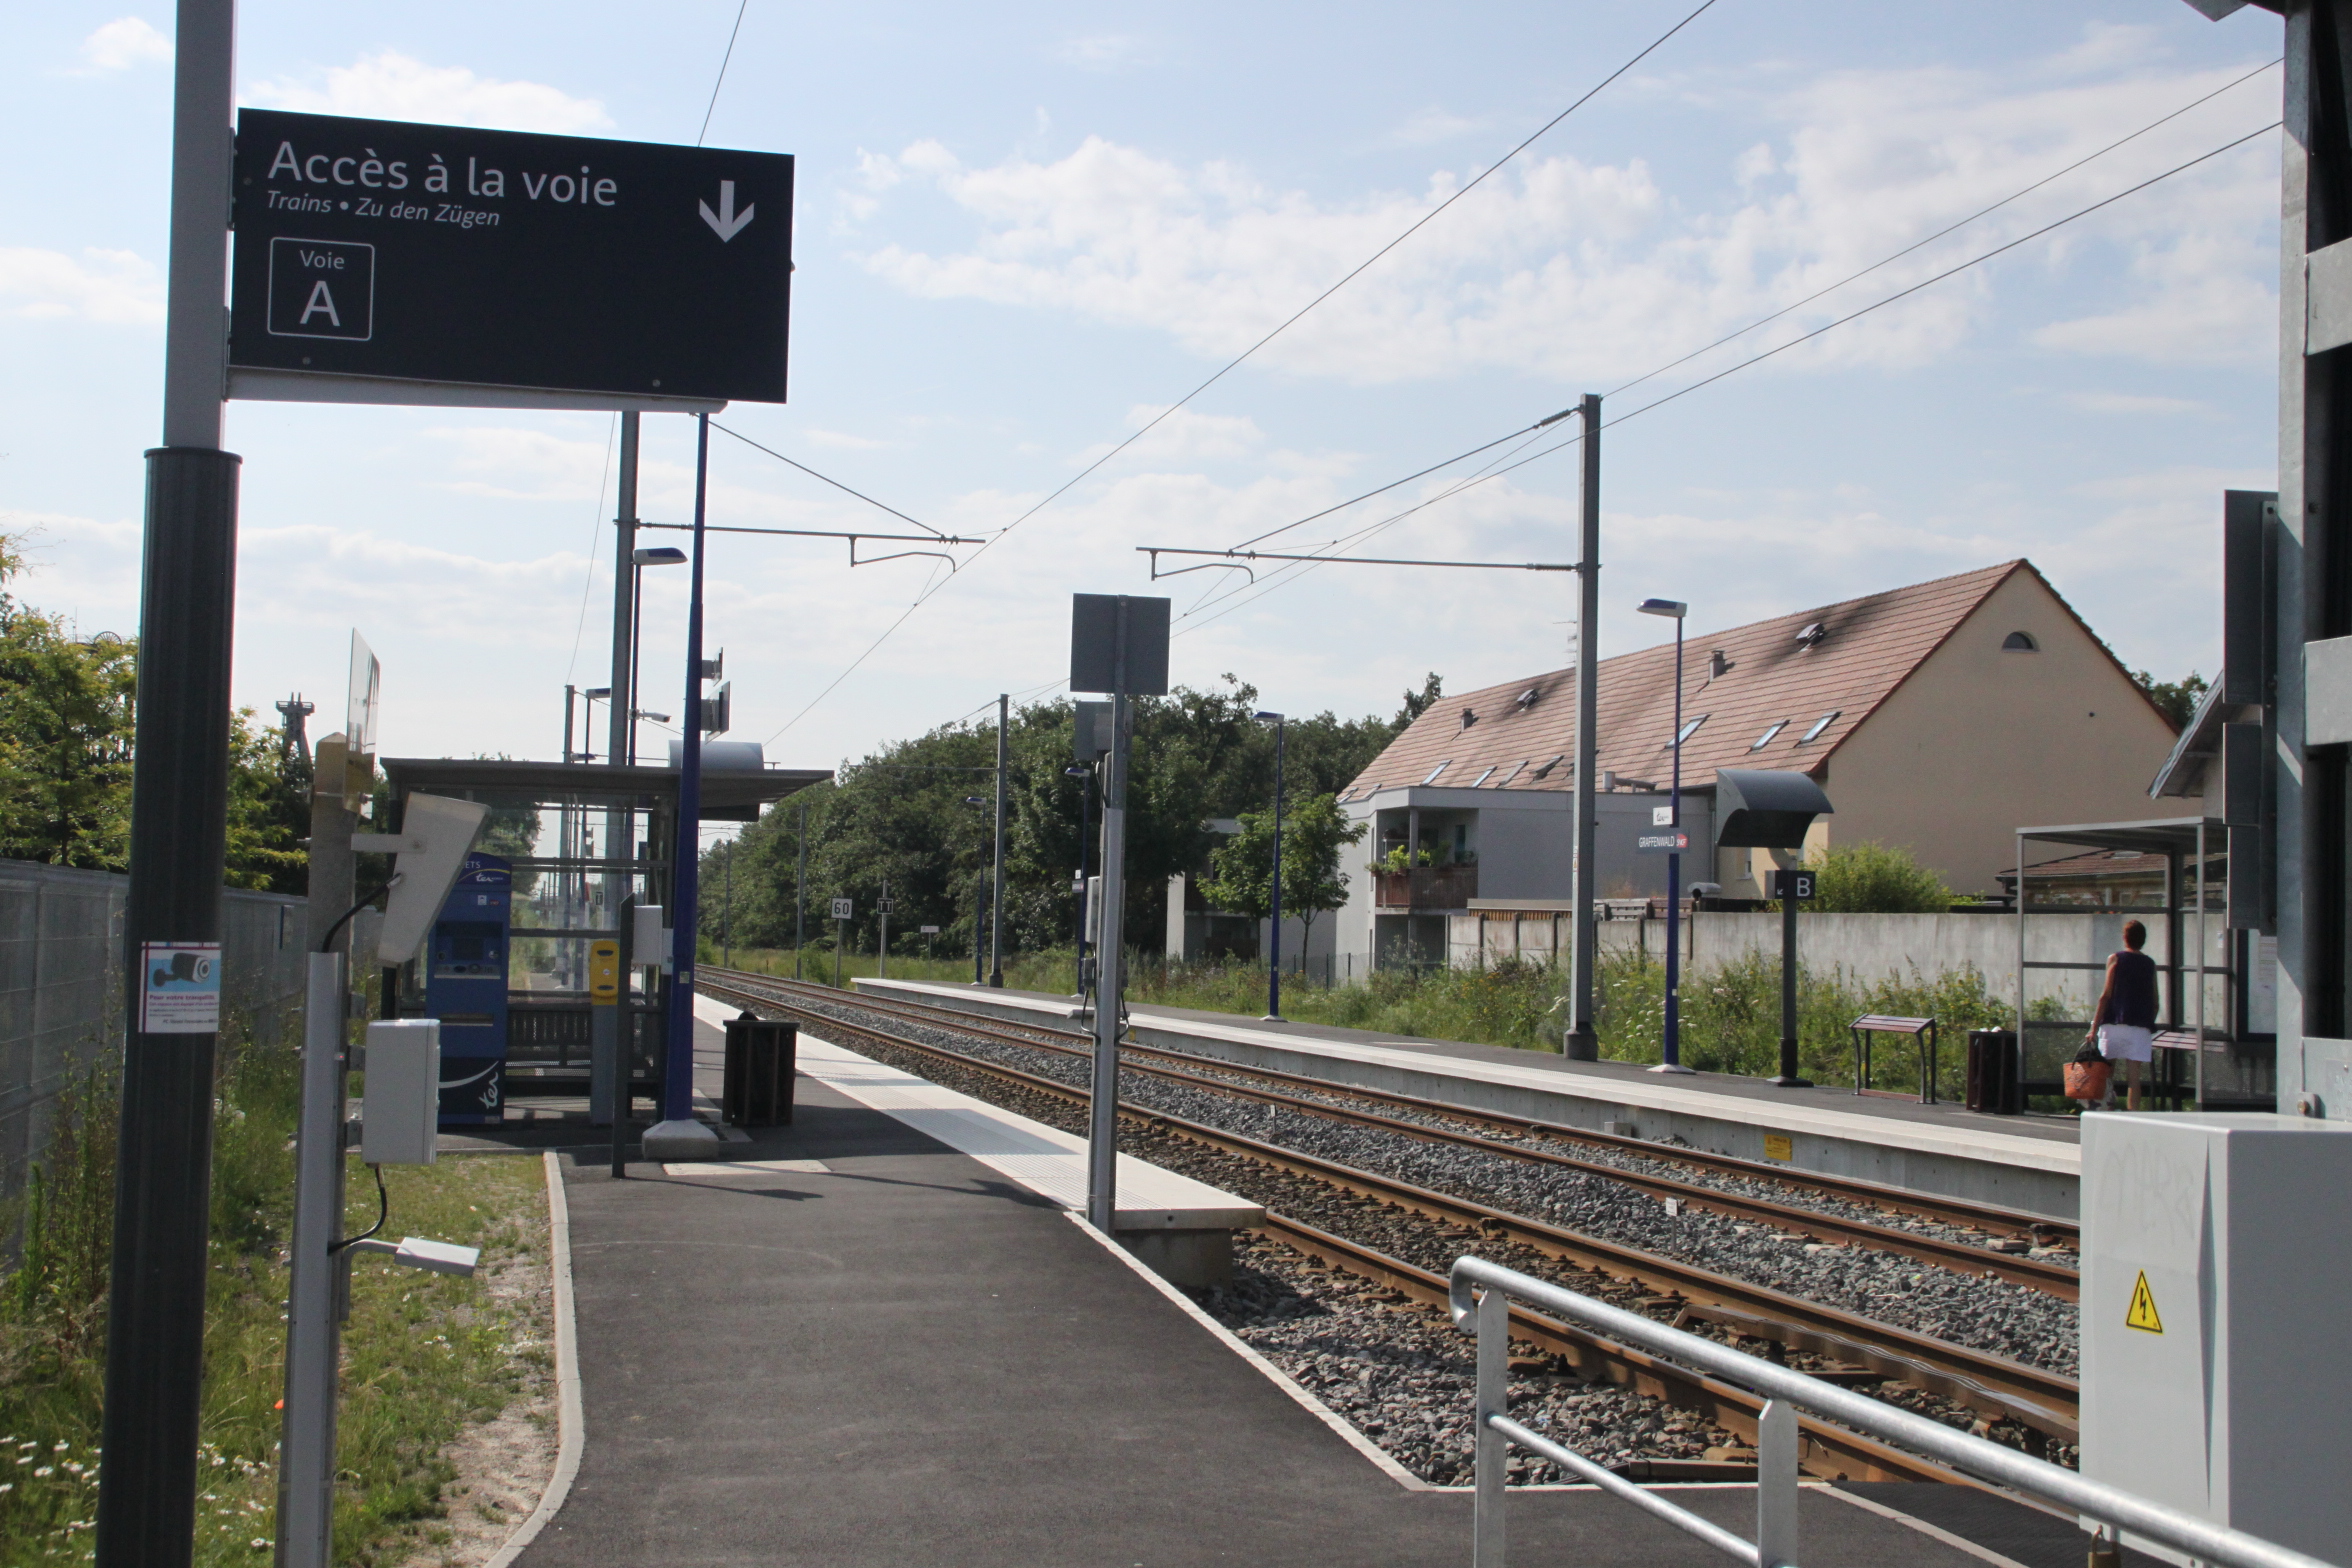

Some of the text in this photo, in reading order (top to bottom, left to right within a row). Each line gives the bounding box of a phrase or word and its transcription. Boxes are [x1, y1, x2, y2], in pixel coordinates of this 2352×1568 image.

[267, 140, 618, 206] Accès à la voie
[267, 190, 500, 229] Trains Zu den Zügen
[300, 249, 345, 270] Voie
[300, 280, 341, 327] A
[1638, 836, 1675, 848] GRAFFENWALD
[465, 860, 481, 869] ETS
[1796, 877, 1811, 897] B
[834, 902, 849, 914] 60
[478, 1071, 499, 1110] ter
